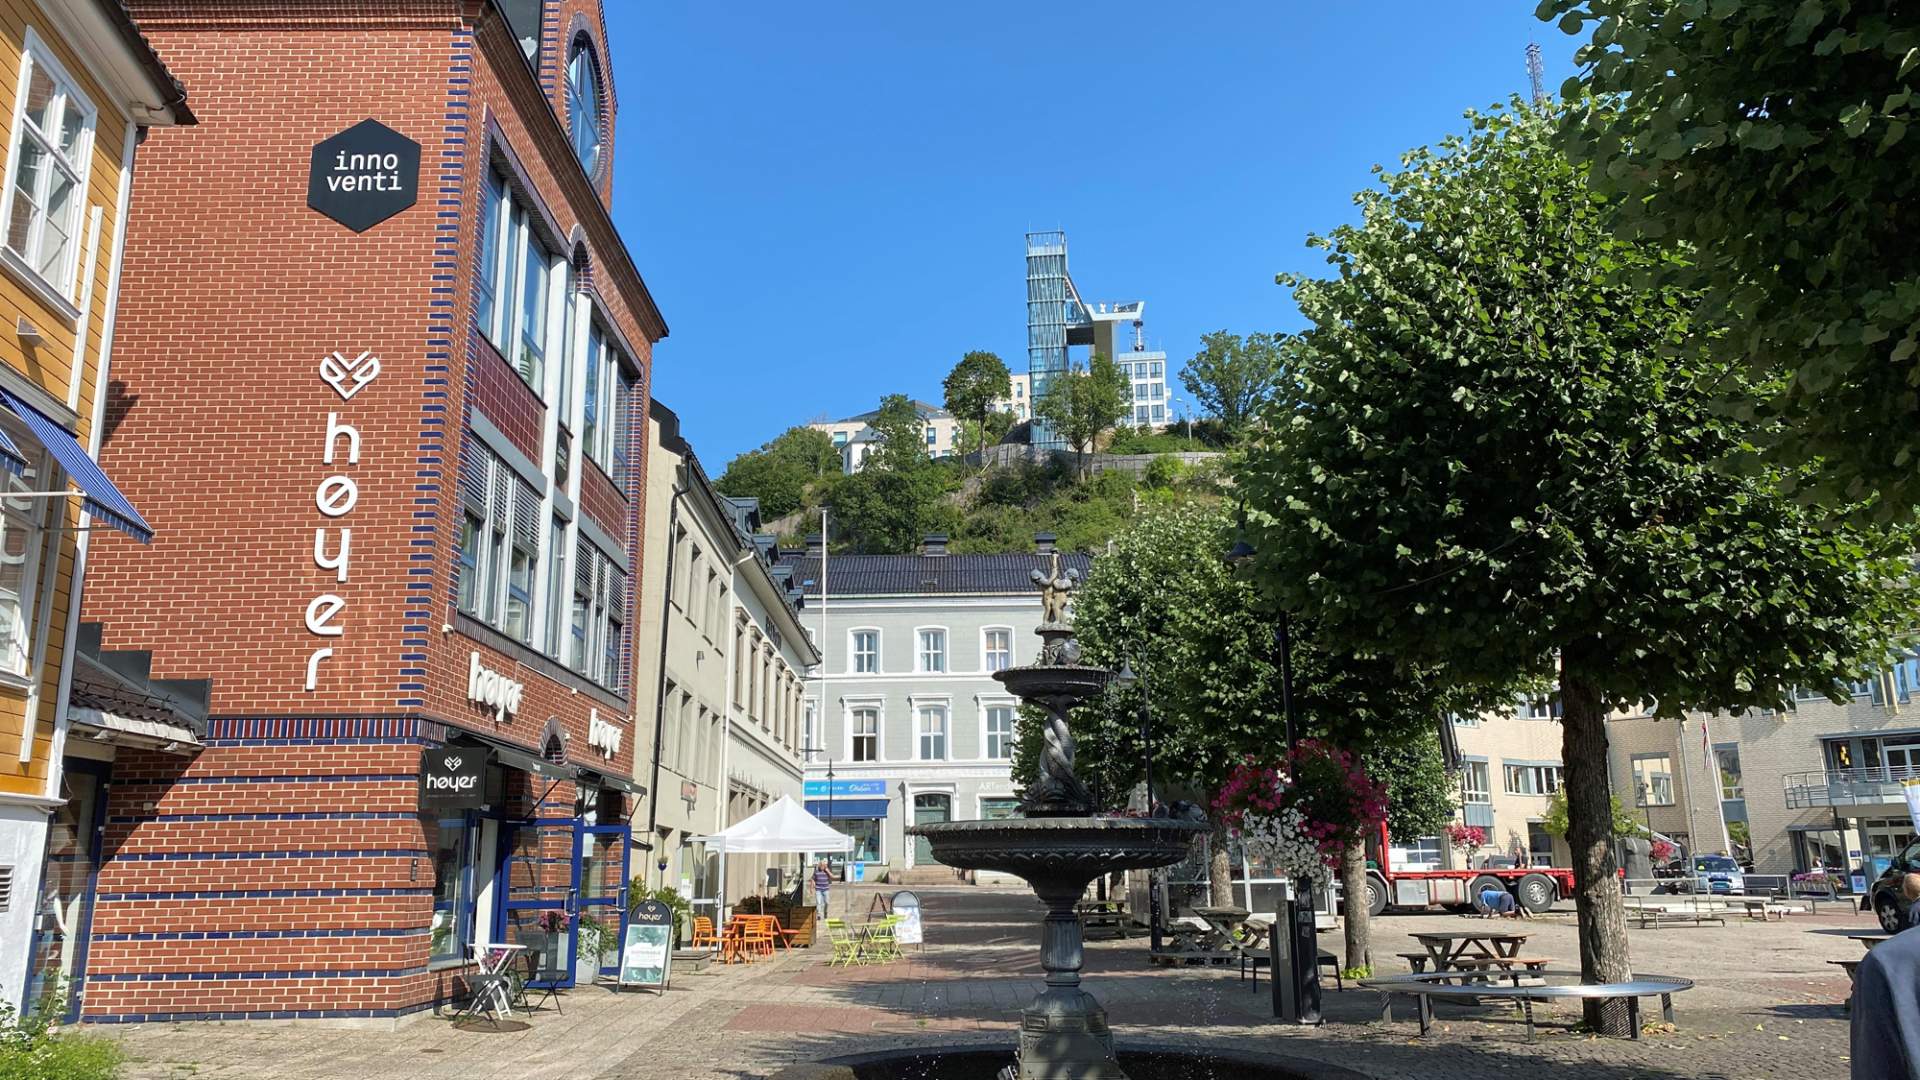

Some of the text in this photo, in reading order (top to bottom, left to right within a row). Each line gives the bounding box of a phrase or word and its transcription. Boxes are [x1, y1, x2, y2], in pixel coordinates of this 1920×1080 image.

[334, 150, 398, 171] inno
[326, 170, 402, 192] venti
[304, 411, 360, 691] høyer
[426, 773, 477, 793] høyer
